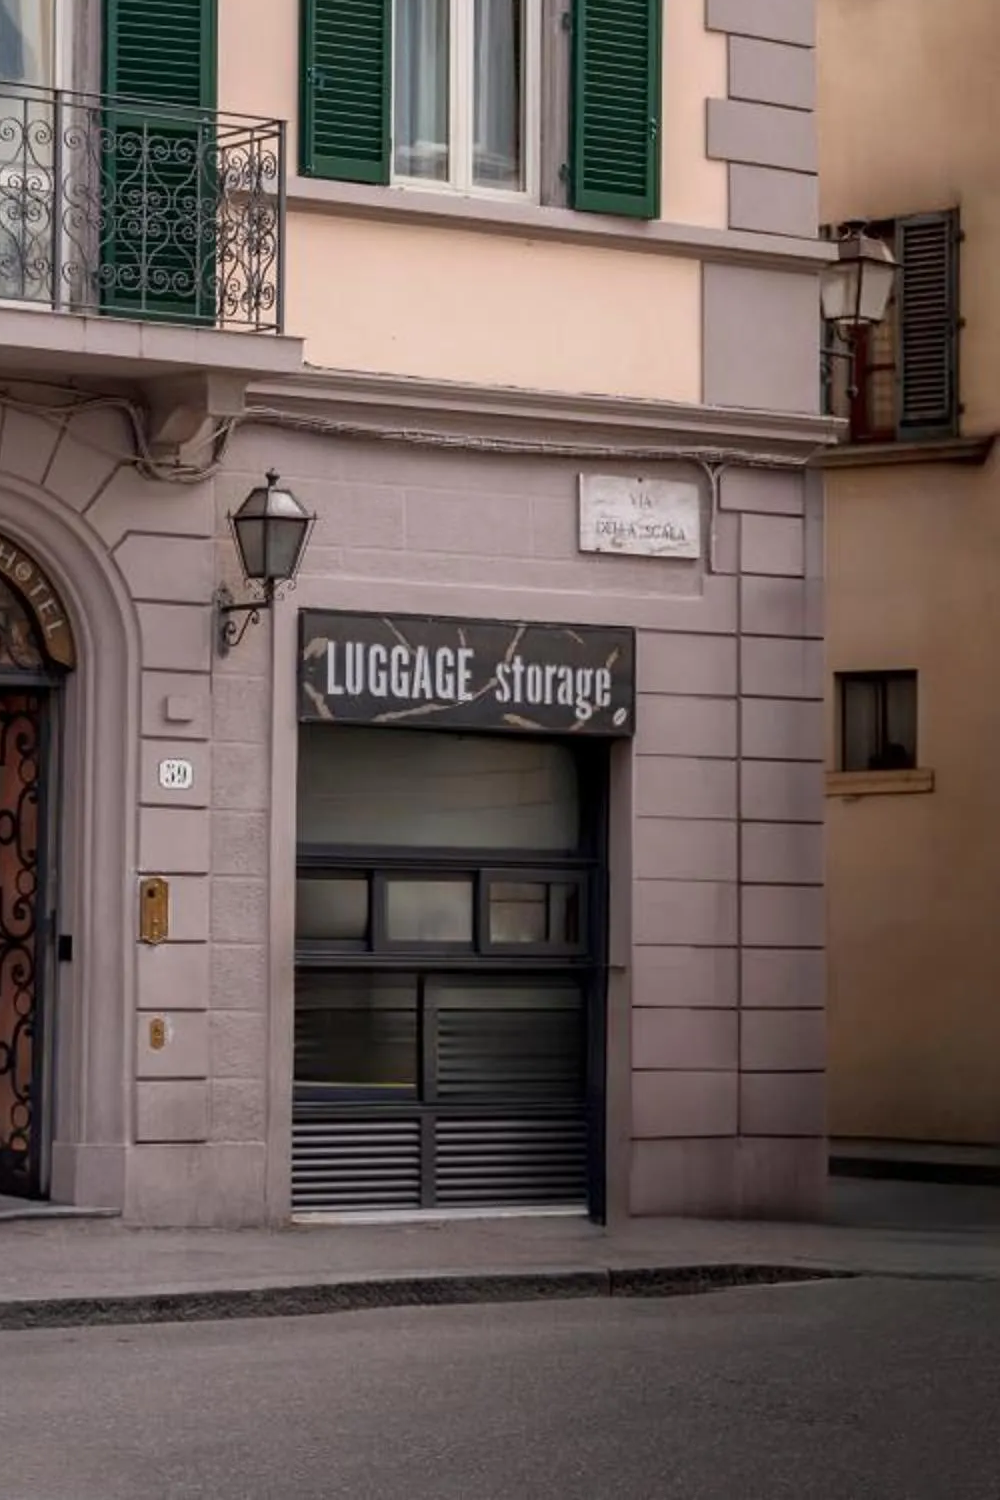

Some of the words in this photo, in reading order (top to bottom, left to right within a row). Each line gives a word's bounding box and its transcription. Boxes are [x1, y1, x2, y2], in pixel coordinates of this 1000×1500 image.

[629, 493, 653, 509] VIA
[326, 640, 475, 701] LUGGAGE
[495, 655, 612, 721] storage
